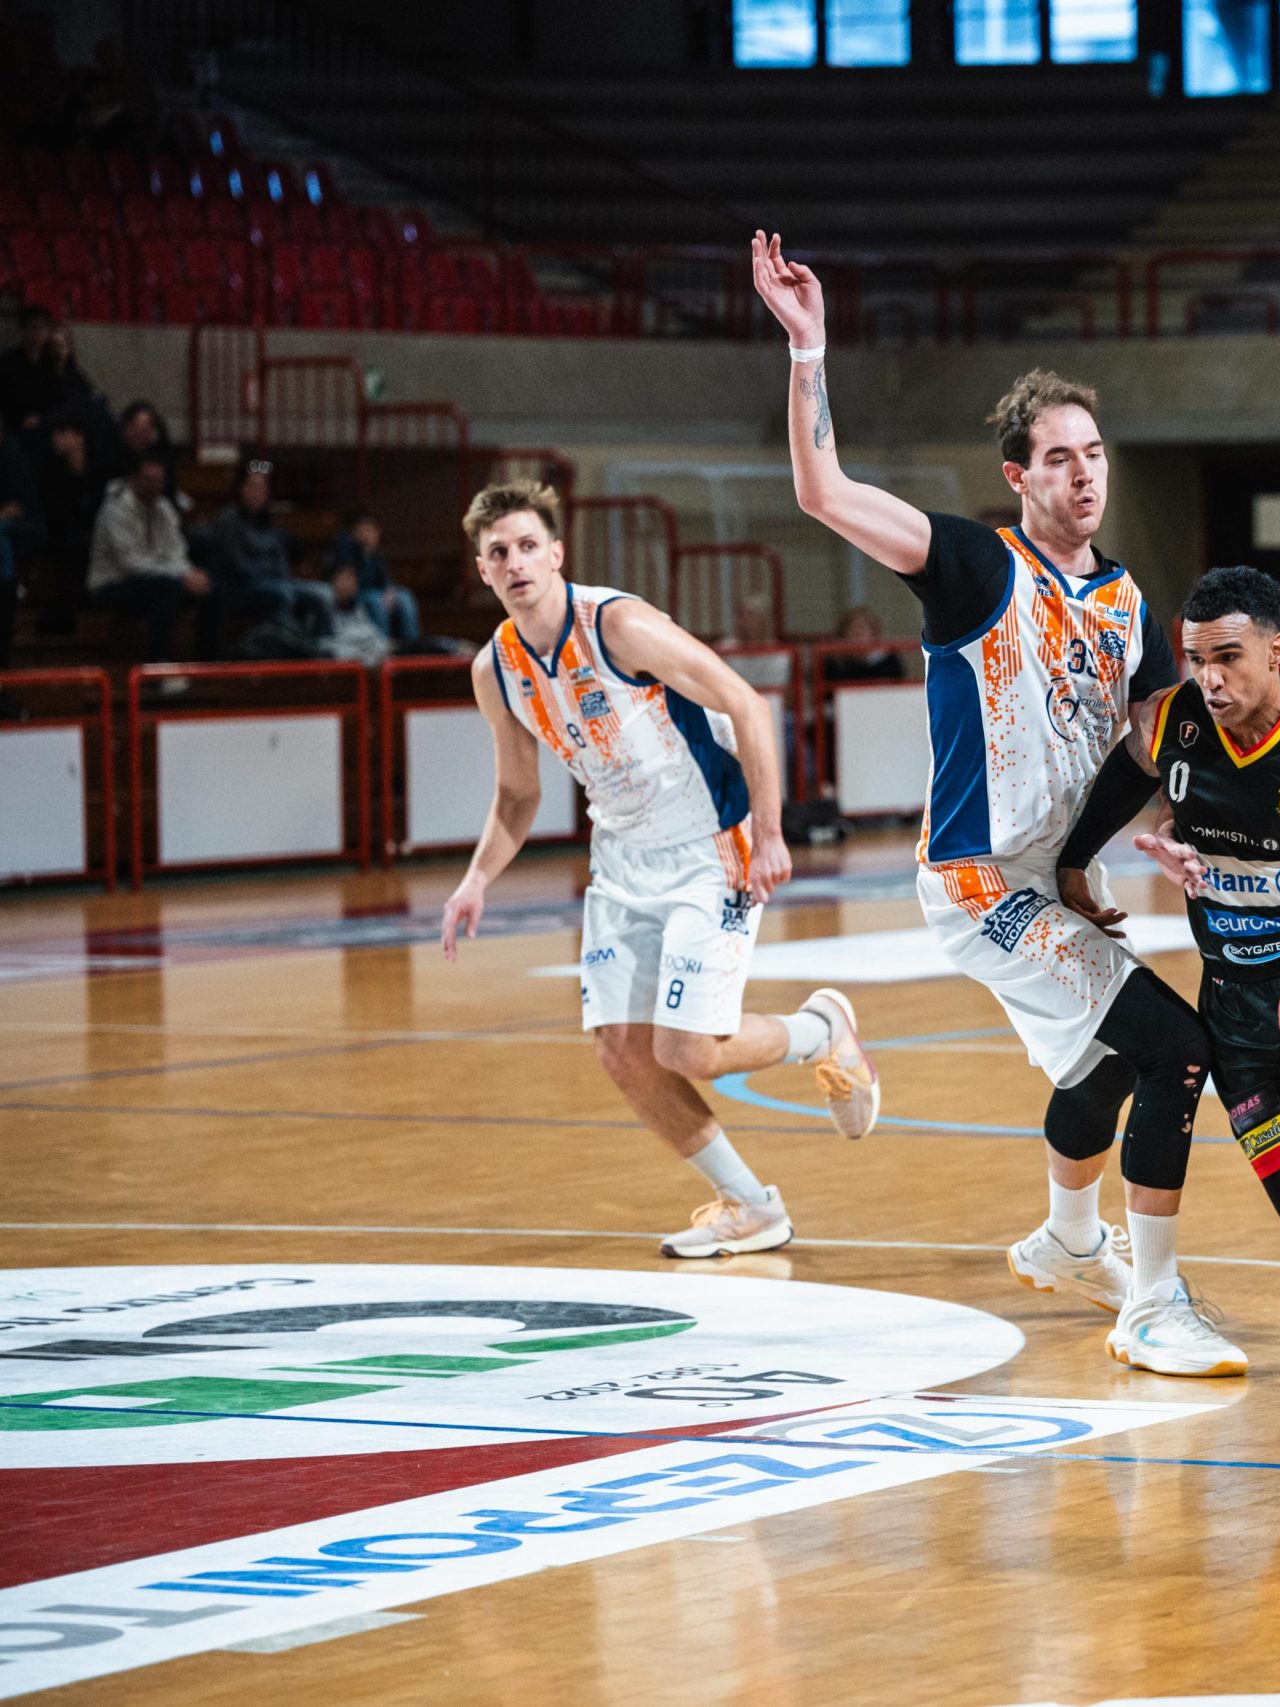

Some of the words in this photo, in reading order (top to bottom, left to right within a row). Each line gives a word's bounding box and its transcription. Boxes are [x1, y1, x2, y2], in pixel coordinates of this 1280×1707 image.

[566, 723, 586, 748] 8
[1184, 724, 1194, 739] F
[1169, 760, 1190, 803] 0
[666, 979, 684, 1009] 8
[631, 1362, 738, 1380] 1982
[525, 1381, 641, 1401] 2022
[137, 1453, 878, 1599] ZEPPONI
